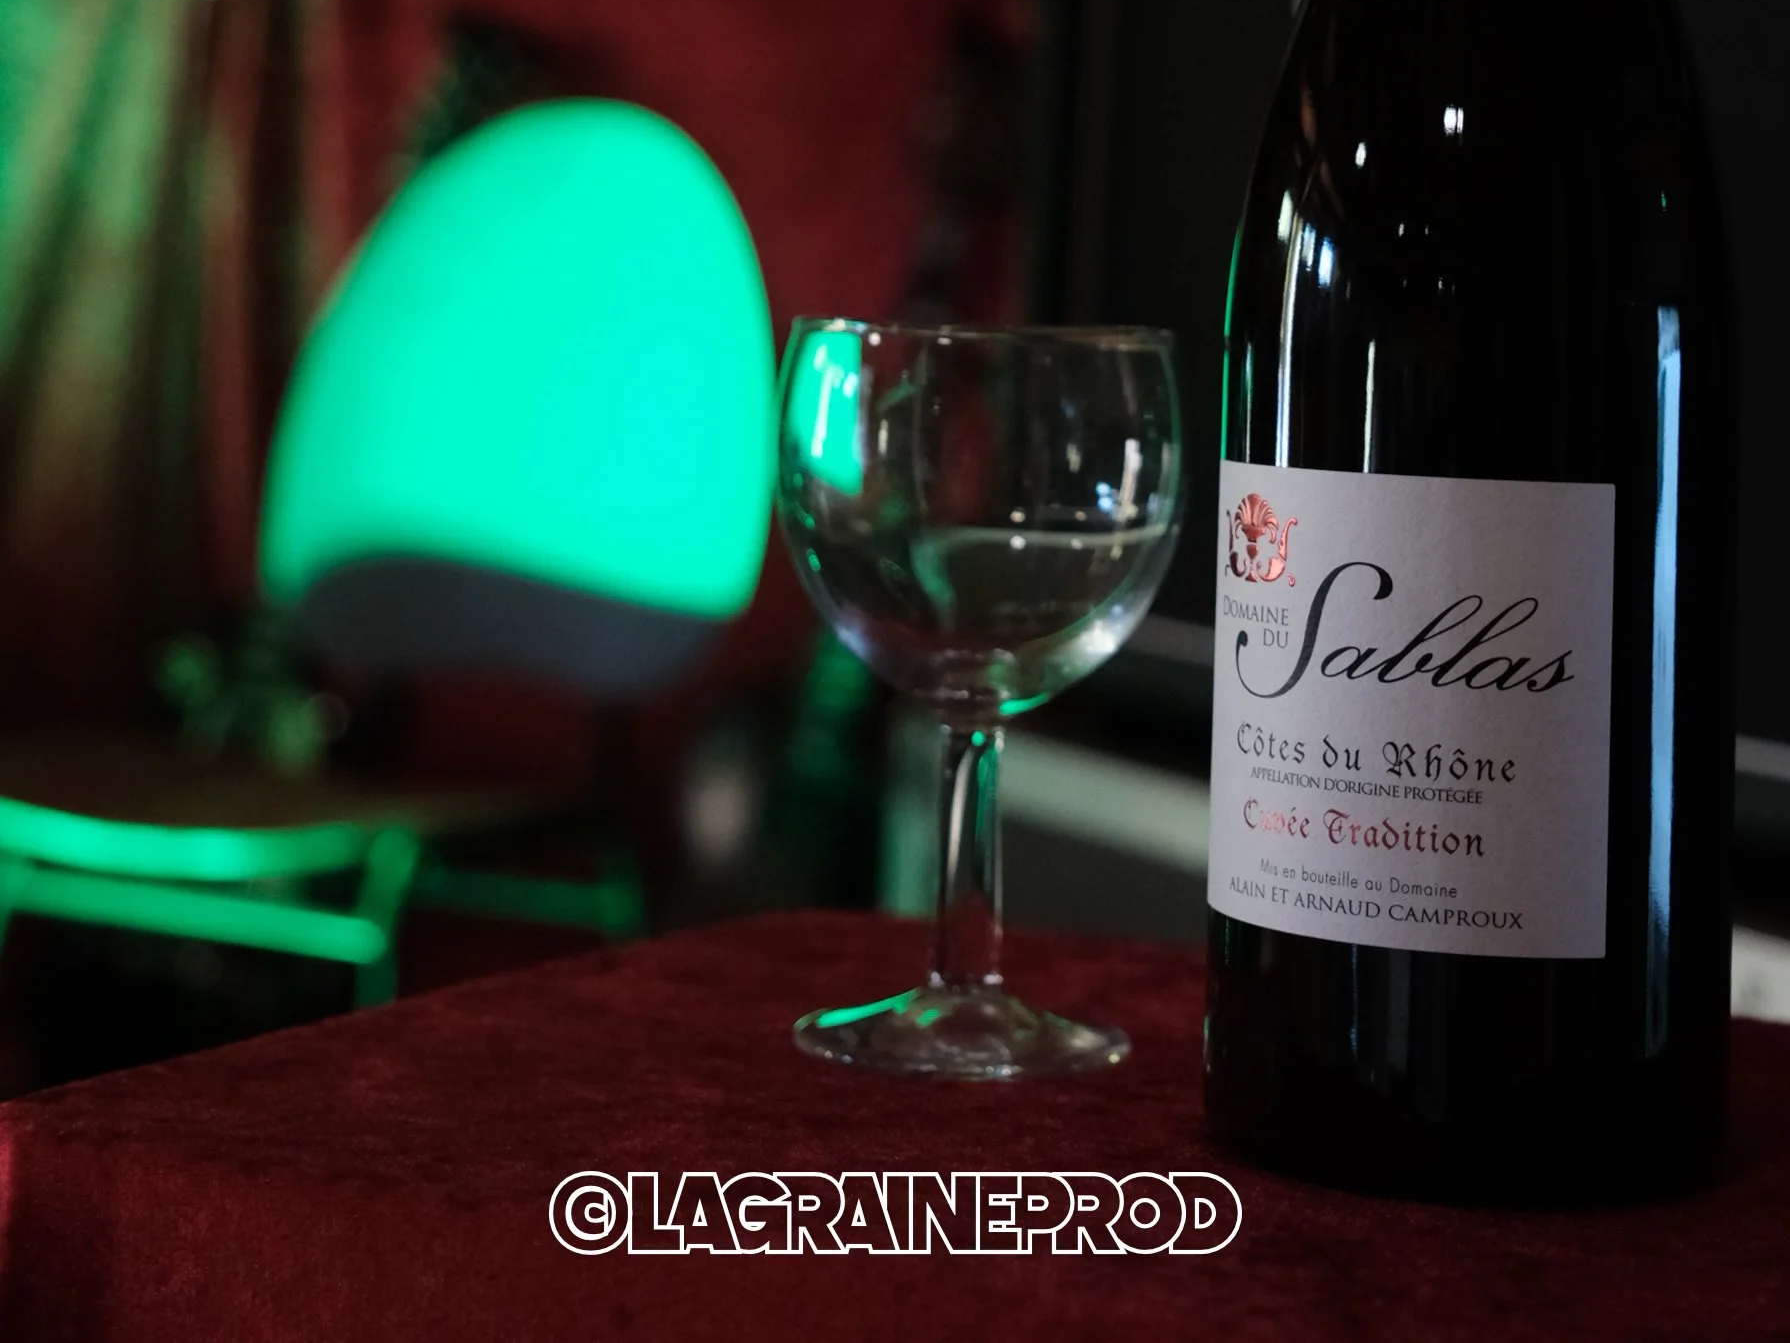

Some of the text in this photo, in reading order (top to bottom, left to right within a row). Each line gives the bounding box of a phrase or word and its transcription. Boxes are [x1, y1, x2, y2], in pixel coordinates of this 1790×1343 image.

[1222, 594, 1290, 627] DOMAINE
[1235, 561, 1576, 699] Sablas
[1262, 627, 1290, 649] DU
[1237, 720, 1517, 783] Côtes du Rhône
[1250, 766, 1484, 805] APPELLATION D'ORIGINE PROTÉGÉE
[1243, 796, 1486, 858] Cuvée Tradition
[1259, 858, 1459, 899] Mis en bouteille au Domaine
[1229, 876, 1524, 931] ALAIN ET ARNAUD CAMPROUX
